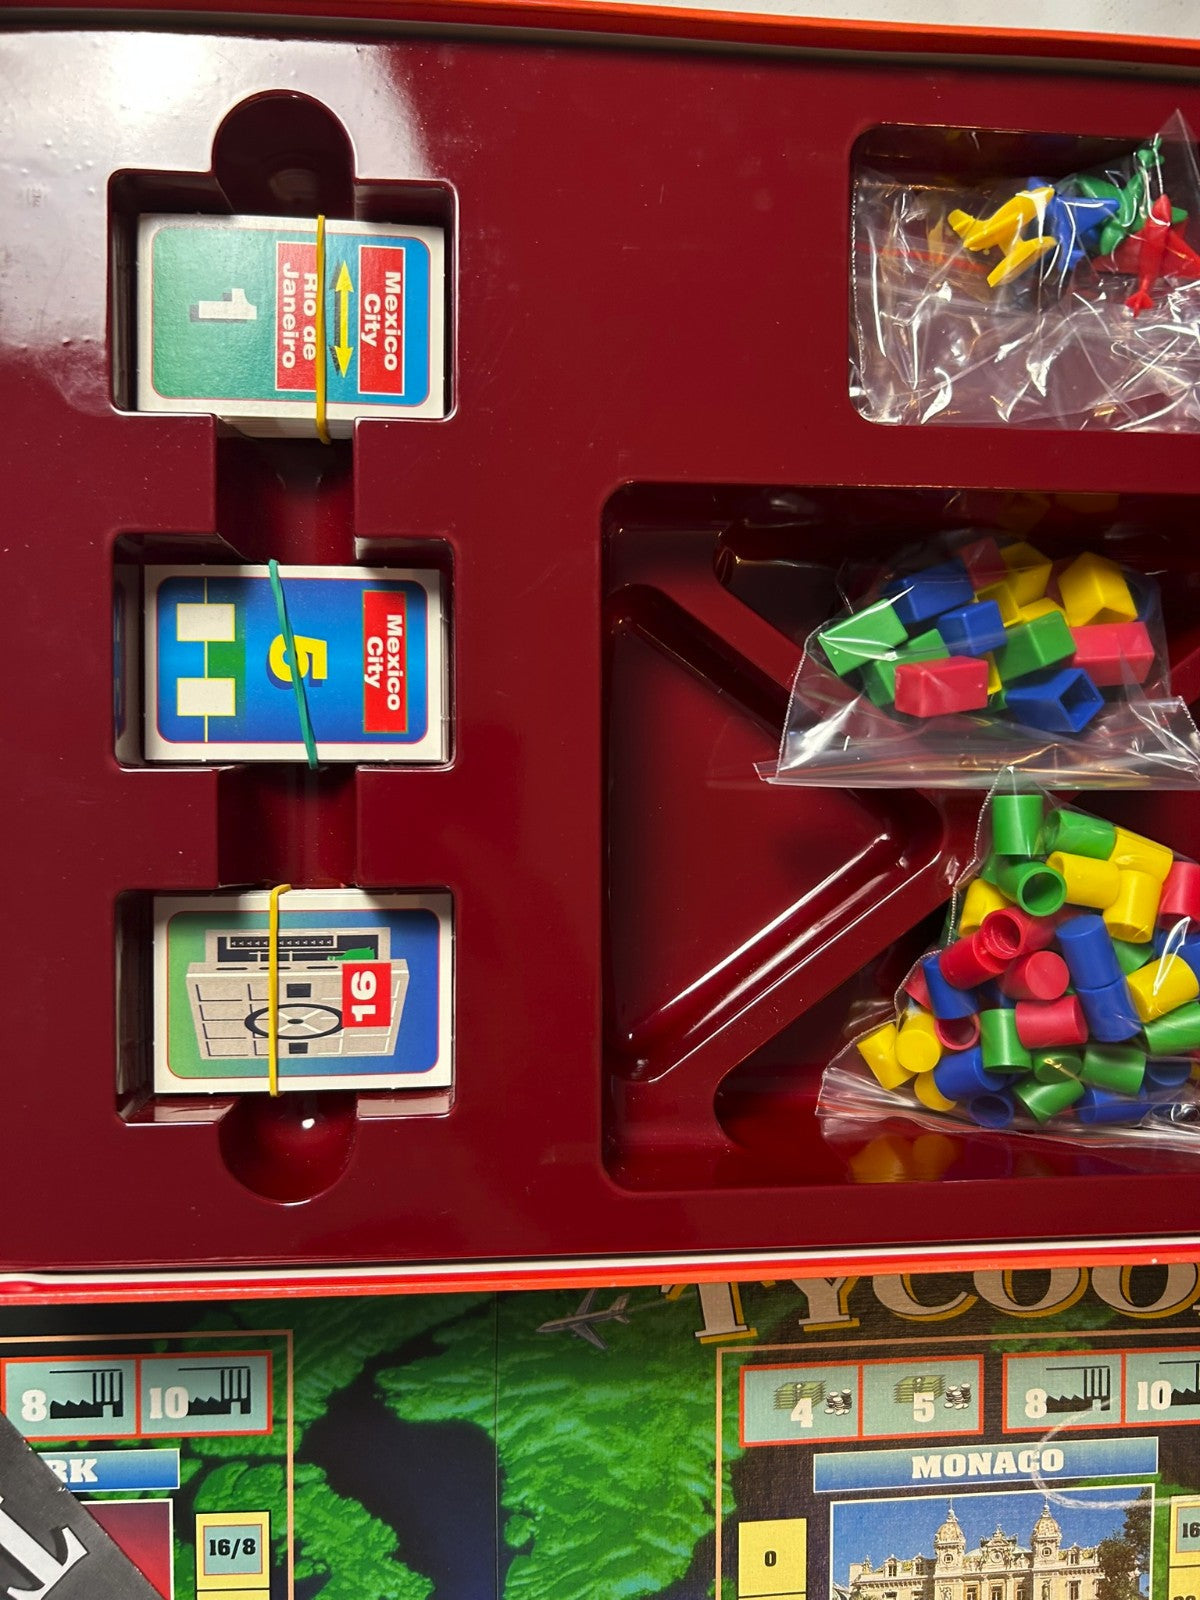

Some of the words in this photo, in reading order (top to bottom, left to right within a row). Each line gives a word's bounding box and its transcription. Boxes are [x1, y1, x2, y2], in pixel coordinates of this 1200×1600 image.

[197, 287, 258, 321] 1
[281, 261, 300, 369] Janeiro
[361, 293, 381, 347] City
[384, 271, 402, 371] Mexico
[268, 633, 328, 681] 5
[363, 636, 384, 689] City
[386, 614, 404, 711] Mexico
[350, 970, 378, 1022] 16
[662, 1263, 1200, 1341] TYCOO
[21, 1389, 47, 1422] 8
[149, 1386, 189, 1419] 10
[790, 1398, 813, 1428] 4
[912, 1391, 936, 1423] 5
[1024, 1388, 1048, 1419] 8
[1137, 1380, 1172, 1411] 10
[911, 1448, 1065, 1480] MONACO
[209, 1538, 256, 1559] 16/8
[764, 1550, 777, 1568] 0
